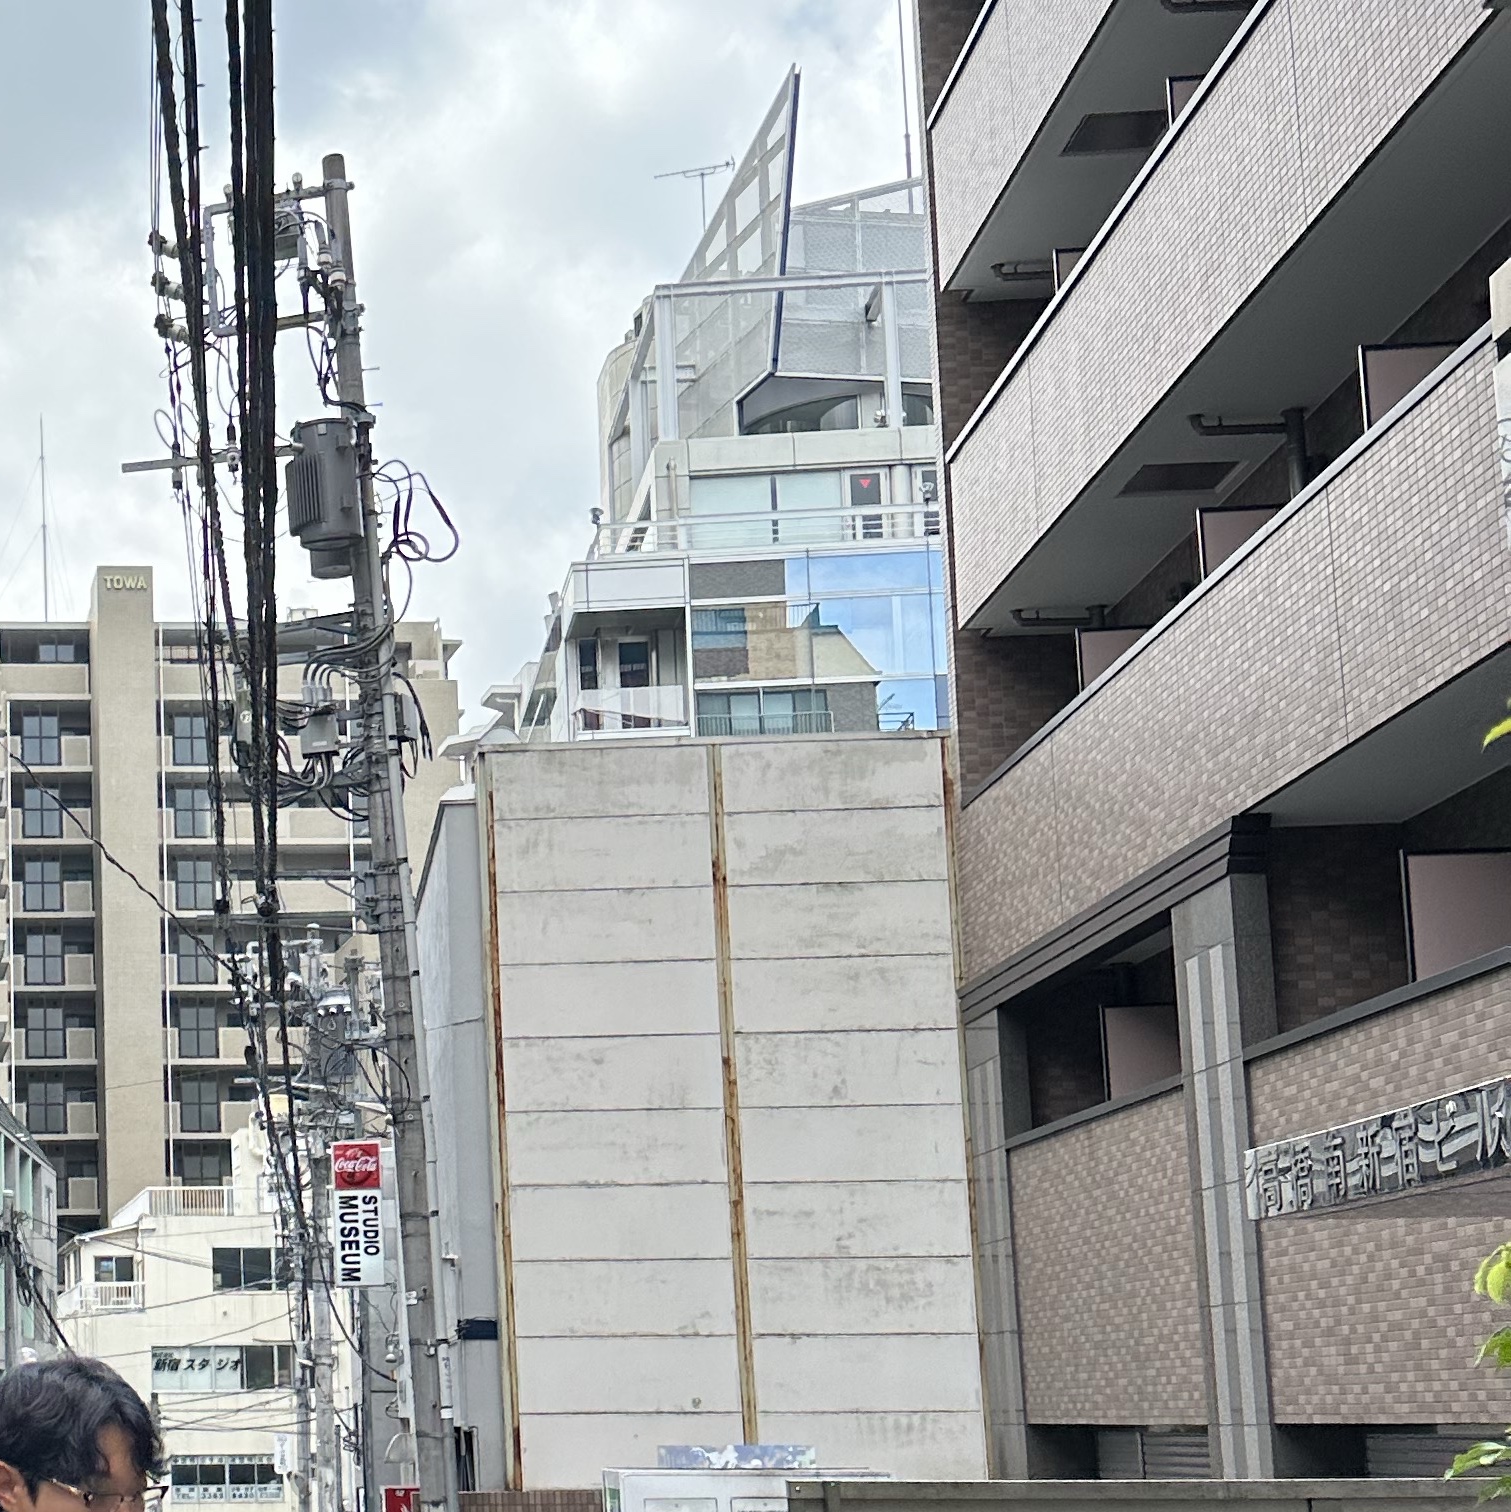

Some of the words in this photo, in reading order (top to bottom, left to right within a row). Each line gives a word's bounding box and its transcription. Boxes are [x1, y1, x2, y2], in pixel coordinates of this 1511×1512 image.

[103, 575, 148, 590] TOWA
[338, 1195, 361, 1282] MUSEUM
[362, 1195, 380, 1256] STUDIO
